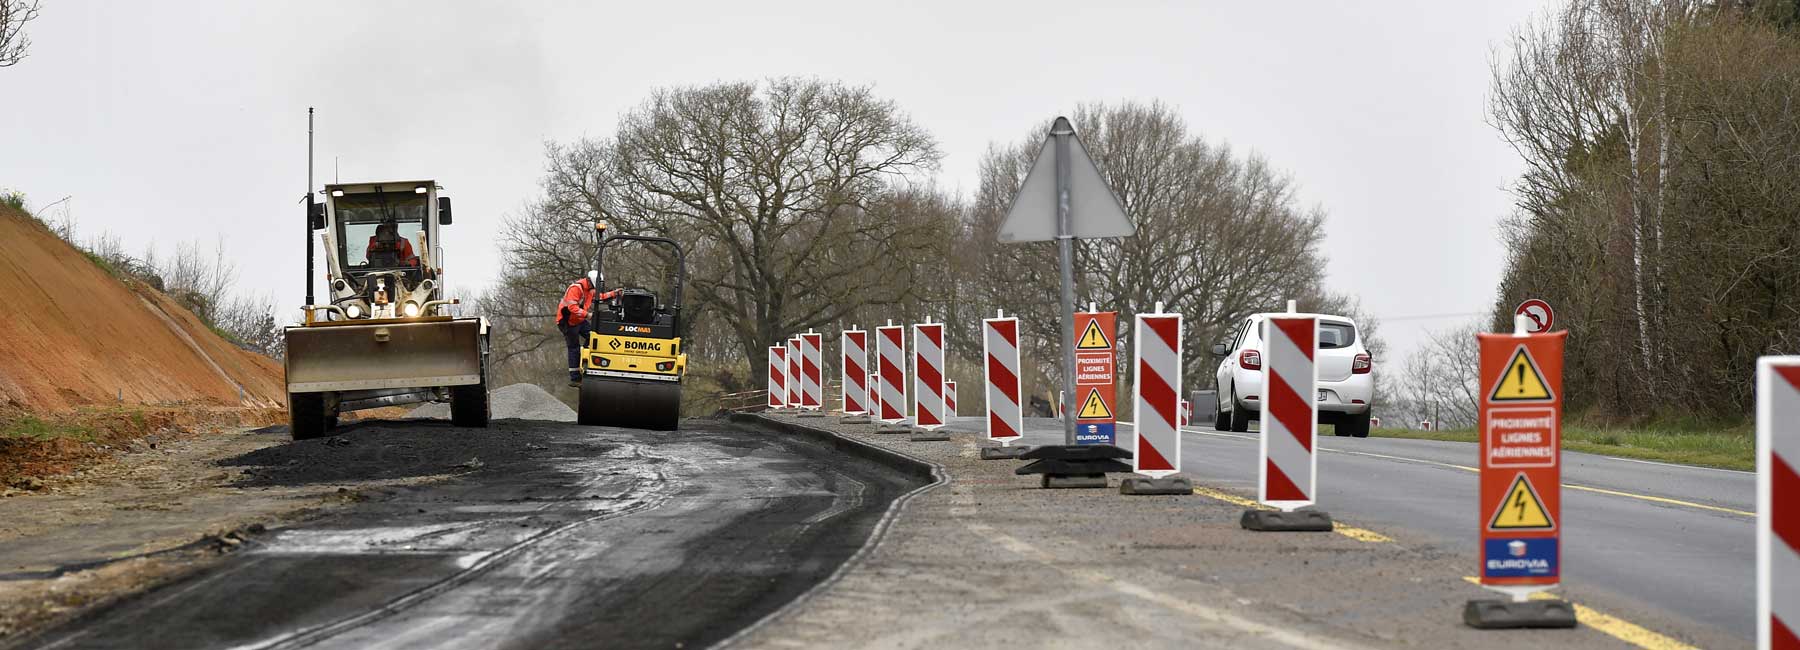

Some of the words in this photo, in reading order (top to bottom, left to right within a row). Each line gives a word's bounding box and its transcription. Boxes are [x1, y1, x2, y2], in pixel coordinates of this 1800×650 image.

[624, 341, 660, 350] BOMAG
[1492, 417, 1551, 428] PROXIMITÉ
[1501, 432, 1542, 443] LIGNES
[1492, 446, 1552, 458] AÉRIENNES
[1488, 560, 1548, 569] EUROVIA
